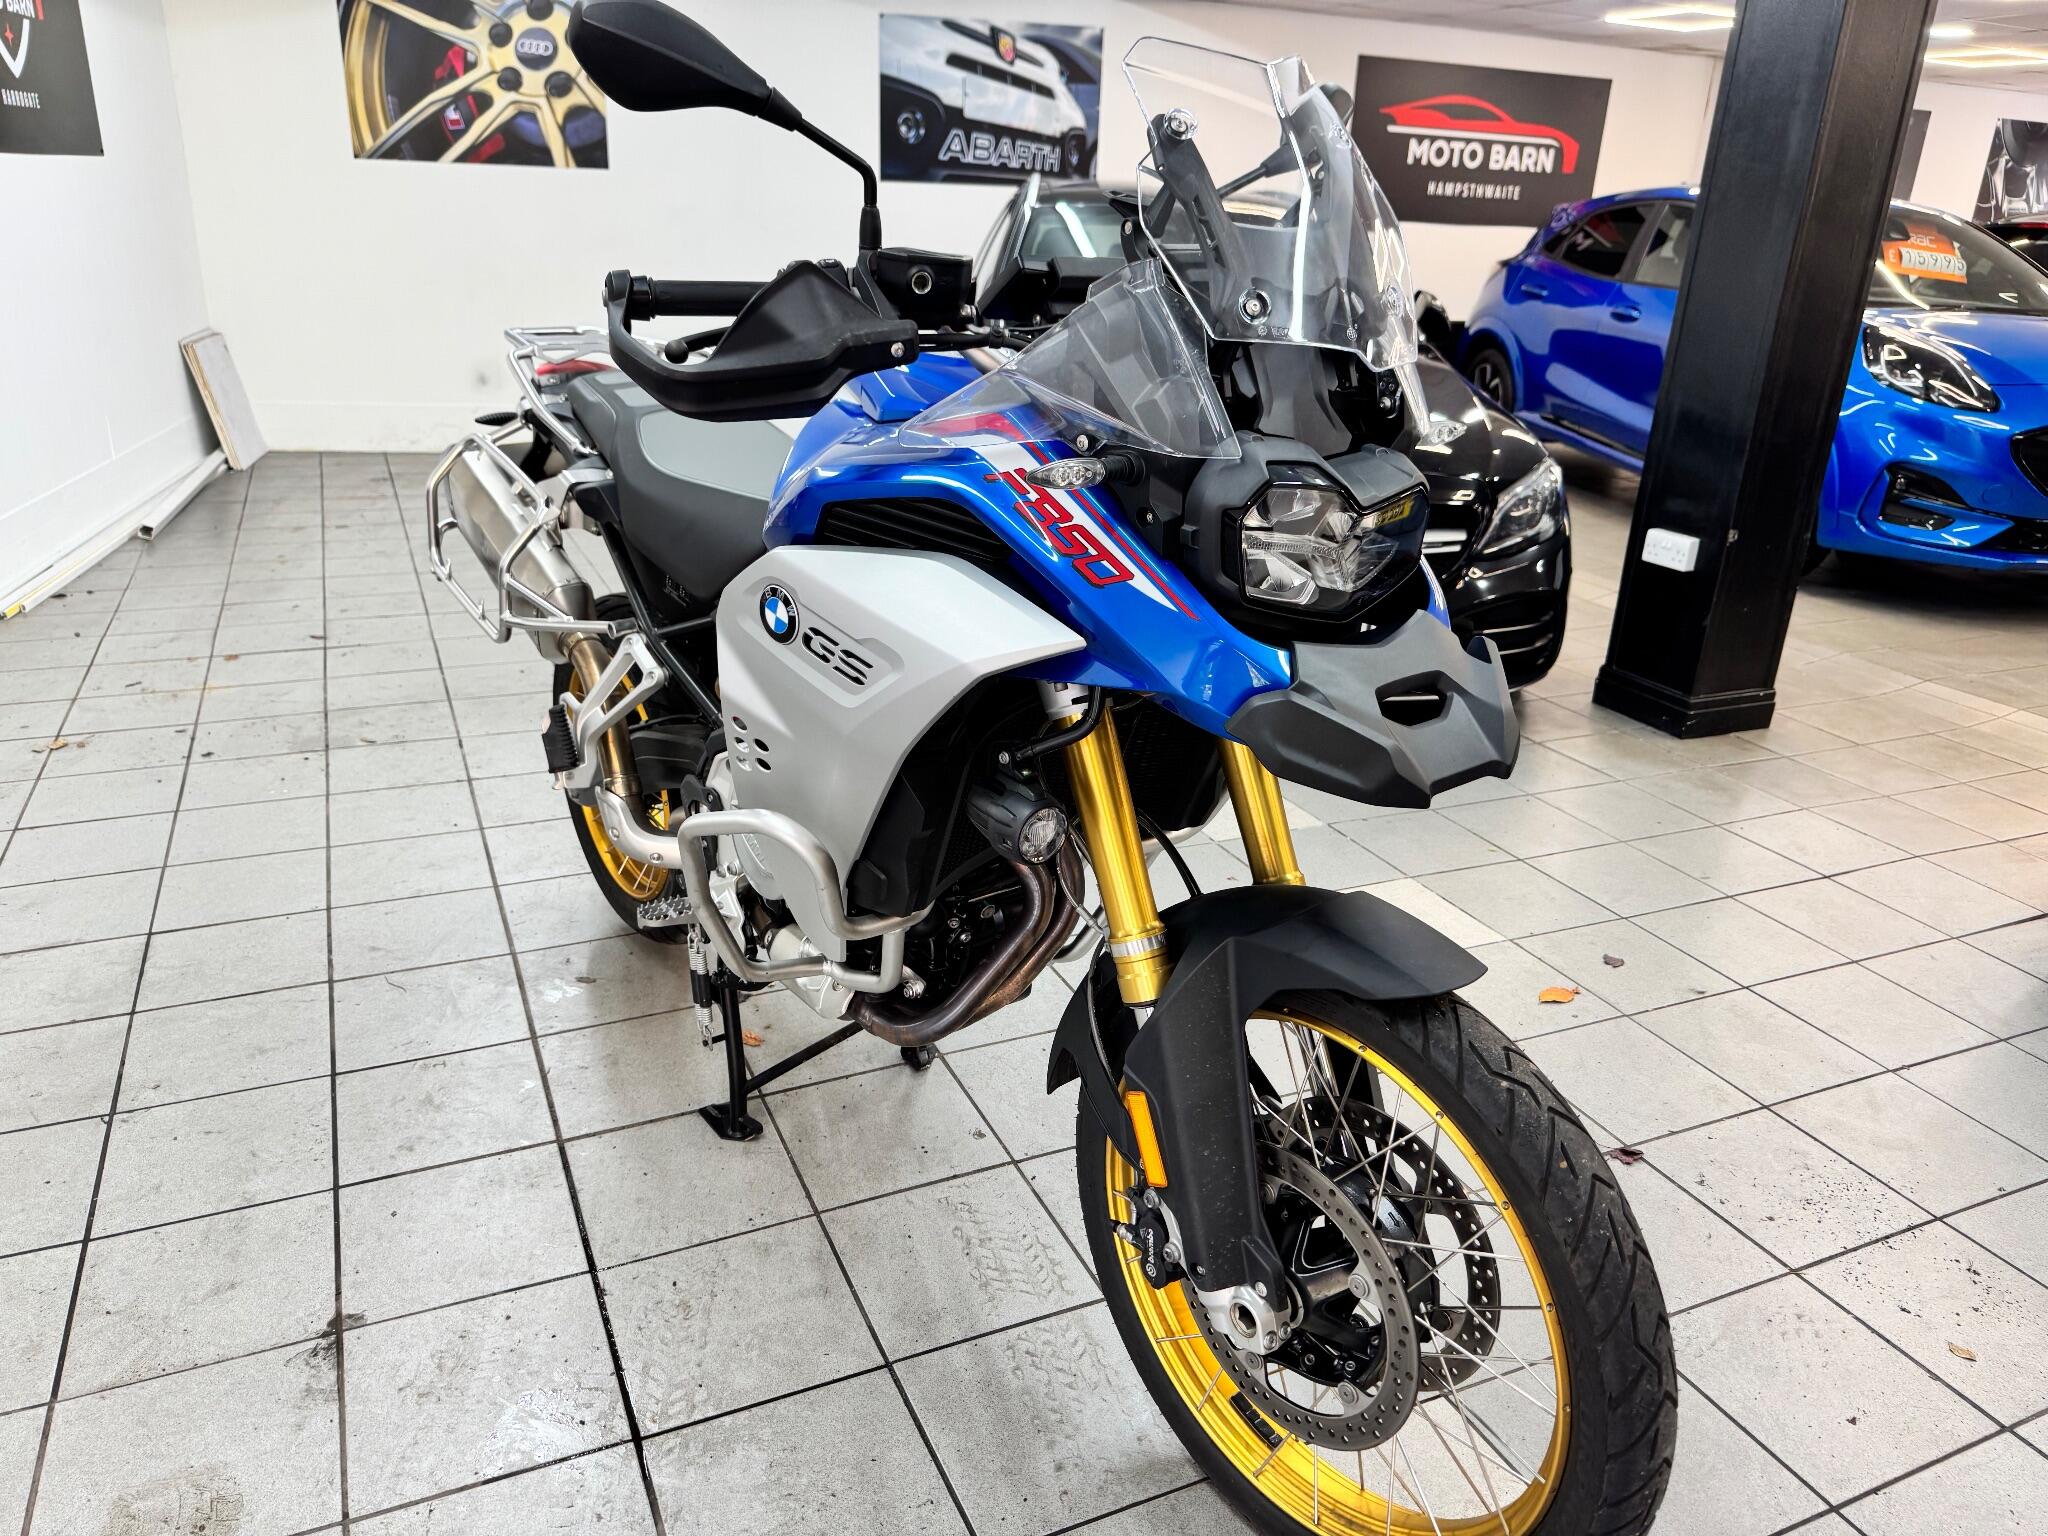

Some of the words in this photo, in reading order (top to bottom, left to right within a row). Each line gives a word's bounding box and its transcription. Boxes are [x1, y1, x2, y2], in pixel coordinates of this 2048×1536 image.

[938, 128, 1062, 173] ABARTH
[1406, 137, 1484, 170] MOTO
[1488, 143, 1556, 174] BARN
[1427, 180, 1521, 201] HAMPSTHWAITE
[801, 626, 874, 686] GS
